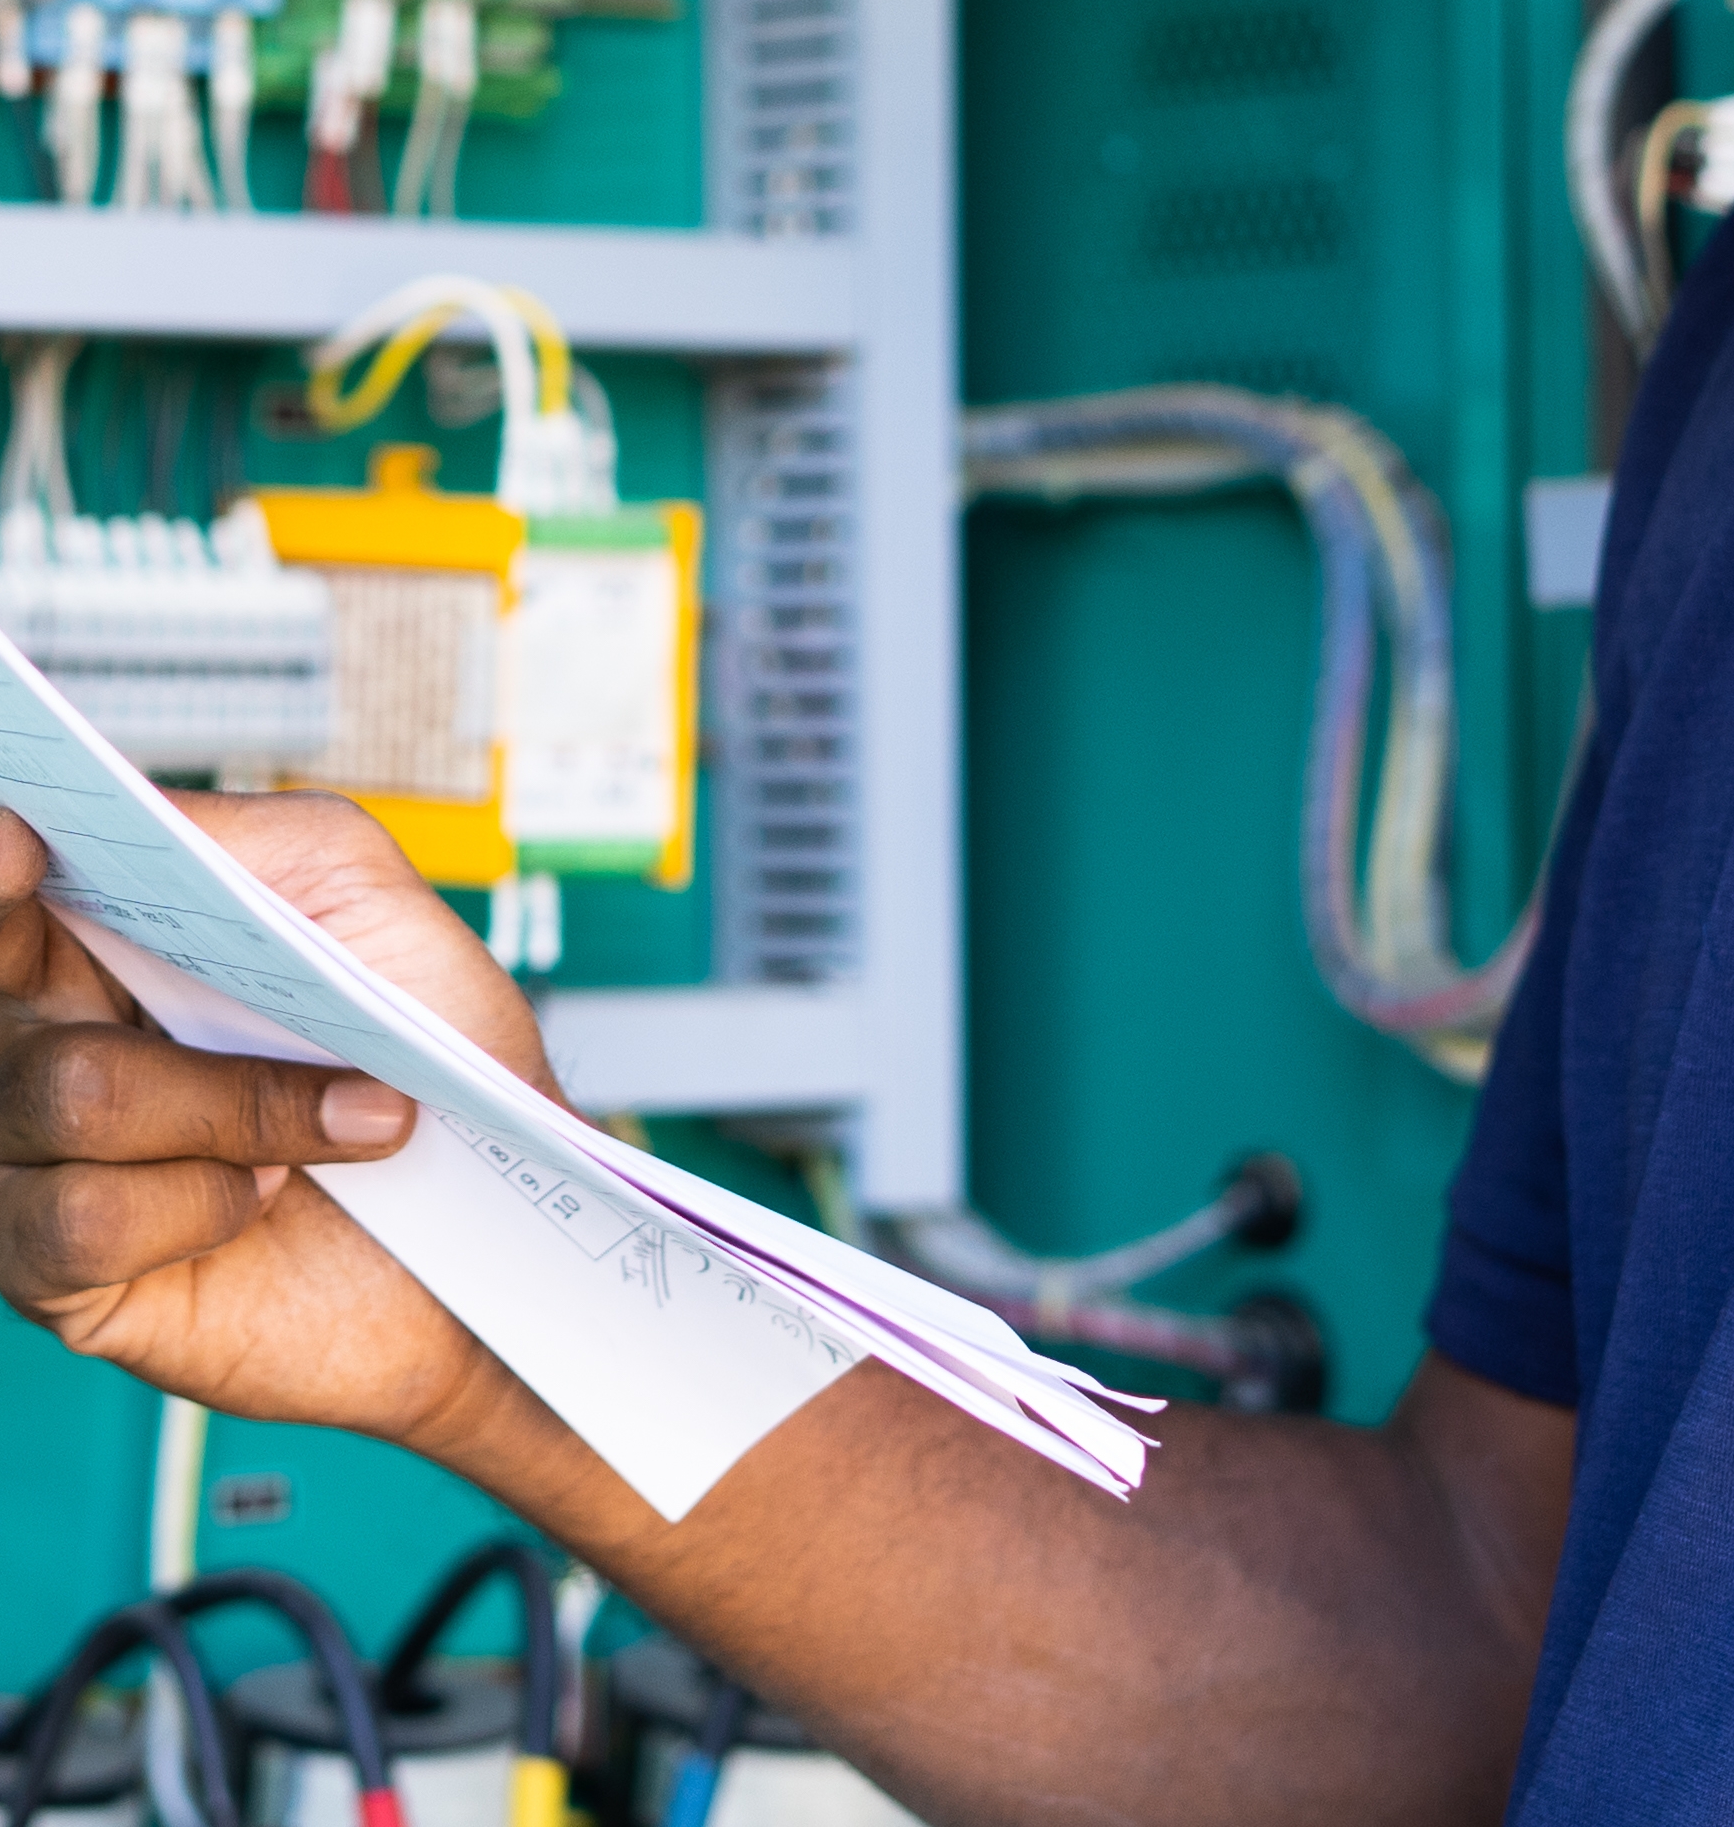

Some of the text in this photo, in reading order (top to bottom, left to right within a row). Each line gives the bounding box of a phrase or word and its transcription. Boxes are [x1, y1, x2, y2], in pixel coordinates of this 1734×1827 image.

[489, 1145, 509, 1163] 8
[520, 1173, 539, 1191] 9
[552, 1194, 581, 1219] 10
